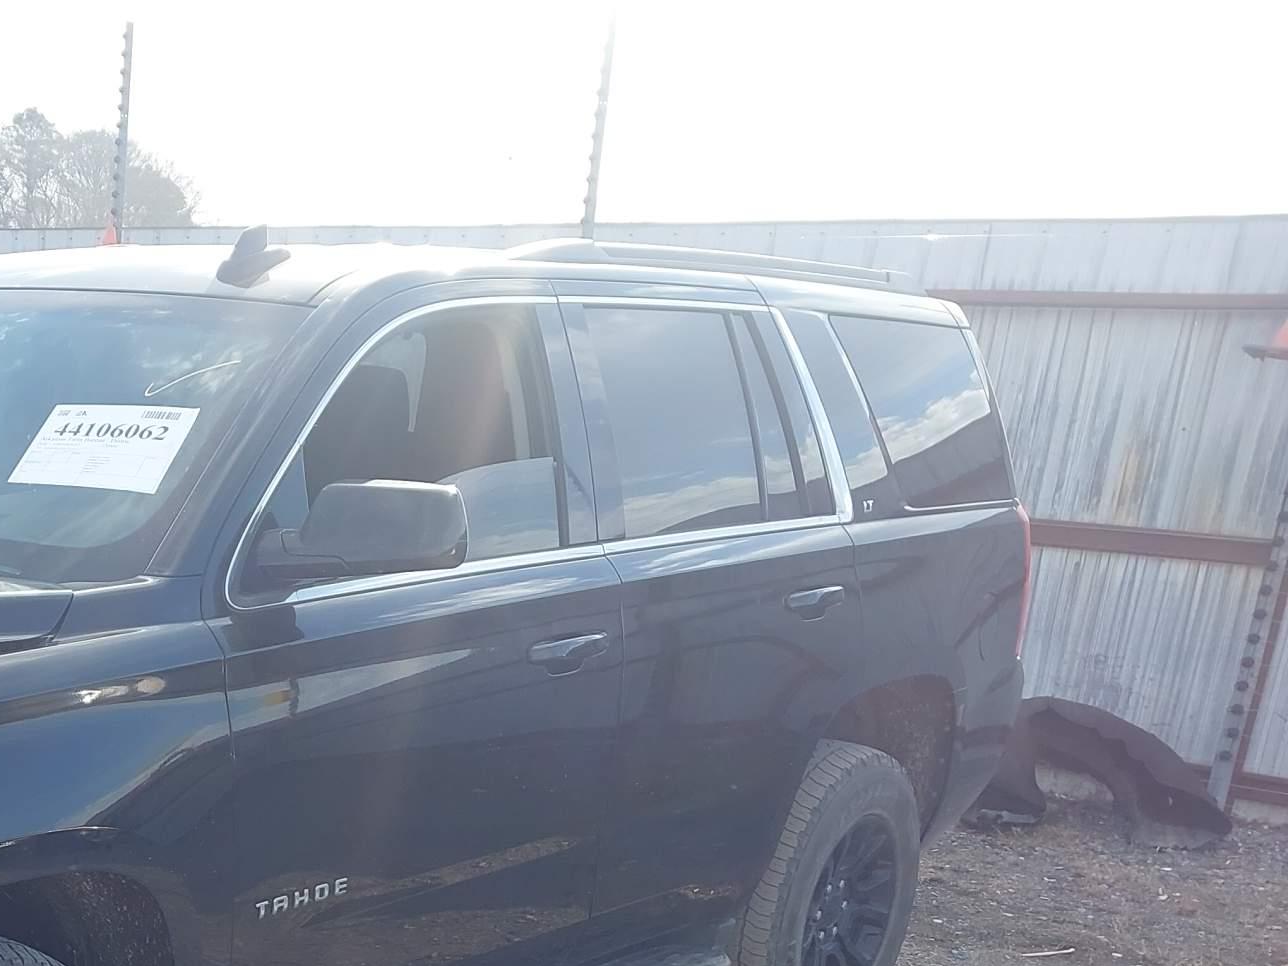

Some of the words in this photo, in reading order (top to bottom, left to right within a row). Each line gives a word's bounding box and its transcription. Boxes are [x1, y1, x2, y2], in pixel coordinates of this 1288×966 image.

[54, 421, 170, 441] 44106062
[863, 499, 874, 513] LT
[255, 877, 349, 920] TAHOE
